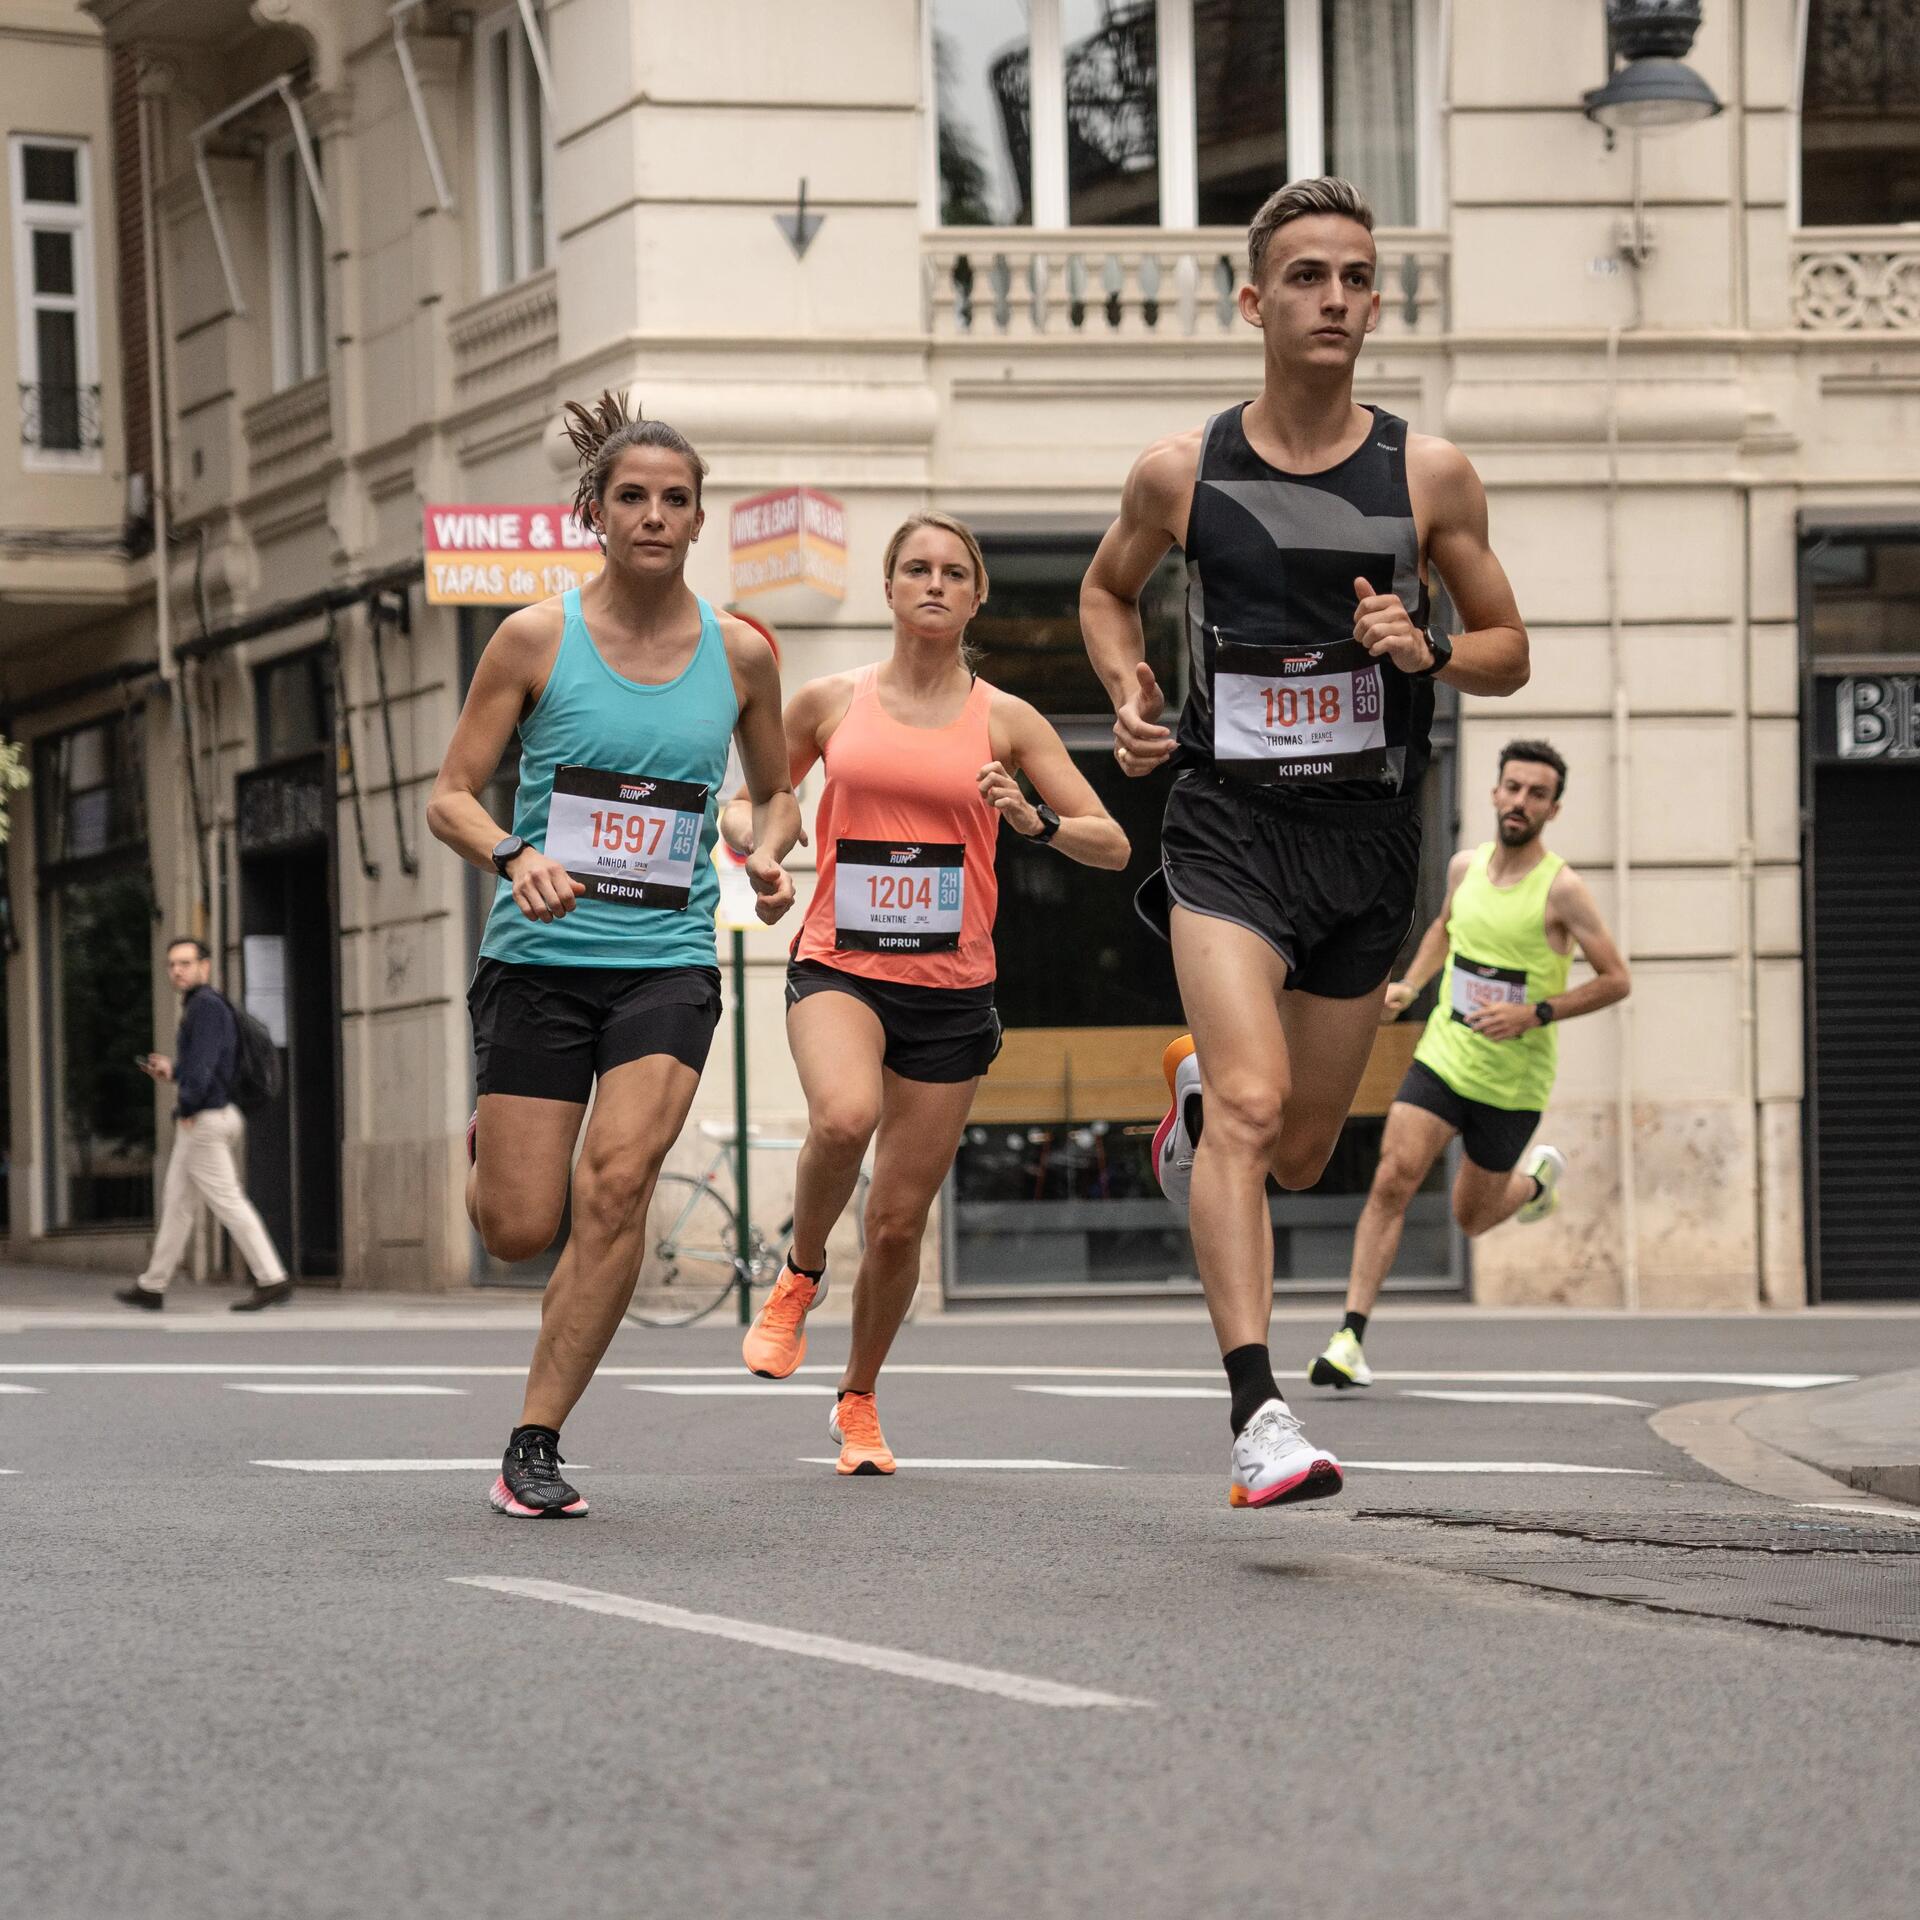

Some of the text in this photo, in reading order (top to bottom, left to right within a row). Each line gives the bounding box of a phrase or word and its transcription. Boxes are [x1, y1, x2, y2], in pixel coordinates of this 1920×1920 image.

[432, 513, 522, 549] WINE
[528, 513, 556, 550] &
[432, 564, 505, 594] TAPAS
[509, 566, 536, 595] de
[1284, 662, 1306, 673] RUN
[1355, 674, 1377, 695] 2H
[1260, 685, 1340, 728] 1018
[1356, 694, 1378, 714] 30
[1266, 731, 1333, 746] THOMAS FRANCE
[1279, 762, 1333, 776] KIPRUN
[619, 789, 638, 800] RUN
[590, 810, 666, 856] 1597
[675, 817, 696, 836] 2H
[673, 836, 692, 855] 45
[596, 856, 627, 869] AINHOA
[890, 855, 907, 864] RUN
[941, 872, 958, 888] 2H
[597, 883, 644, 899] KIPRUN
[867, 875, 932, 910] 1204
[940, 889, 957, 904] 30
[870, 914, 907, 924] VALENTINE
[878, 937, 920, 948] KIPRUN
